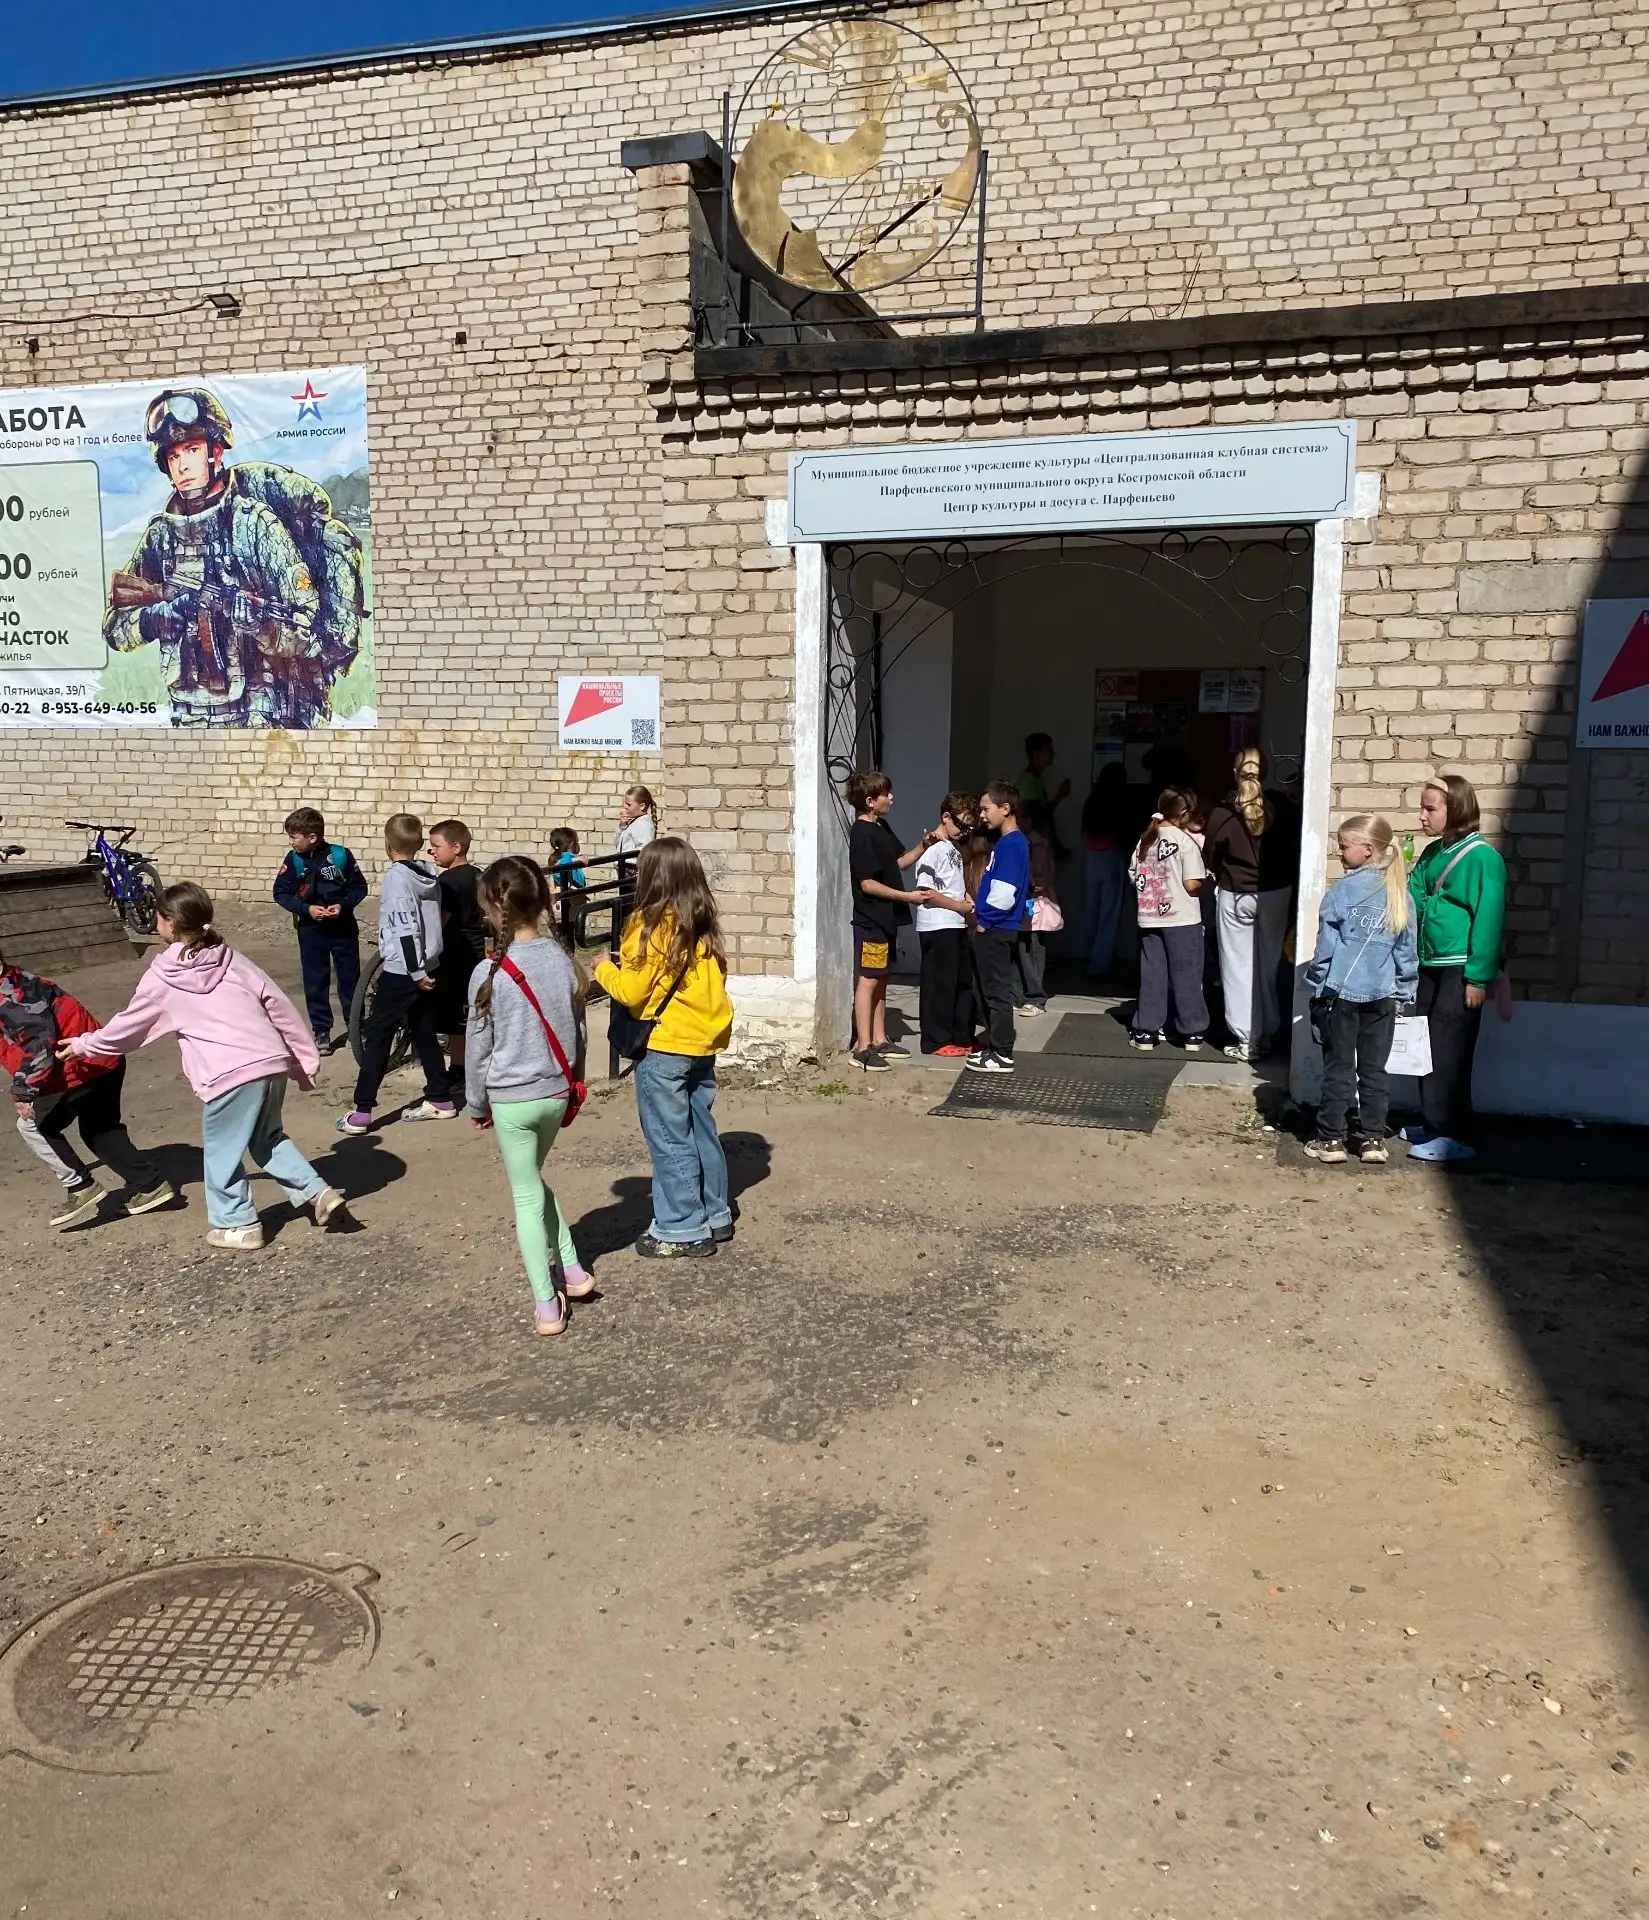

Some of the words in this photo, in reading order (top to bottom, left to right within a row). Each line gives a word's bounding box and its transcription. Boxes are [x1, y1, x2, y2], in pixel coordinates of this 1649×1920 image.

[276, 430, 308, 439] АРМИЯ
[310, 427, 346, 437] РОССИИ
[0, 439, 43, 451] обороны
[45, 437, 61, 447] РФ
[63, 438, 75, 446] на
[76, 436, 81, 446] 1
[83, 436, 100, 446] год
[103, 435, 109, 443] и
[112, 433, 143, 443] более
[811, 467, 899, 482] Муниципальное
[901, 464, 962, 476] бюджетное
[964, 459, 1032, 473] учреждение
[1034, 457, 1091, 470] культуры
[1094, 451, 1214, 464] «Централизованная
[1217, 446, 1268, 459] клубная
[1272, 444, 1329, 455] система»
[880, 483, 971, 497] Парфеньевского
[974, 478, 1071, 493] муниципального
[1074, 476, 1113, 489] округа
[1117, 470, 1195, 484] Костромской
[1198, 469, 1247, 480] области
[0, 495, 24, 522] 0
[29, 507, 70, 521] рублей
[943, 502, 978, 514] Центр
[981, 500, 1036, 512] культуры
[1050, 498, 1087, 509] досуга
[1102, 493, 1175, 507] Парфеньево
[38, 568, 78, 581] рублей
[0, 630, 69, 646] ЧАСТОК
[3, 685, 63, 697] Пятницкая,
[66, 685, 86, 696] 39/1
[0, 702, 31, 715] 0-22
[41, 701, 157, 714] 8-953-649-40-56
[1588, 724, 1612, 737] НАМ
